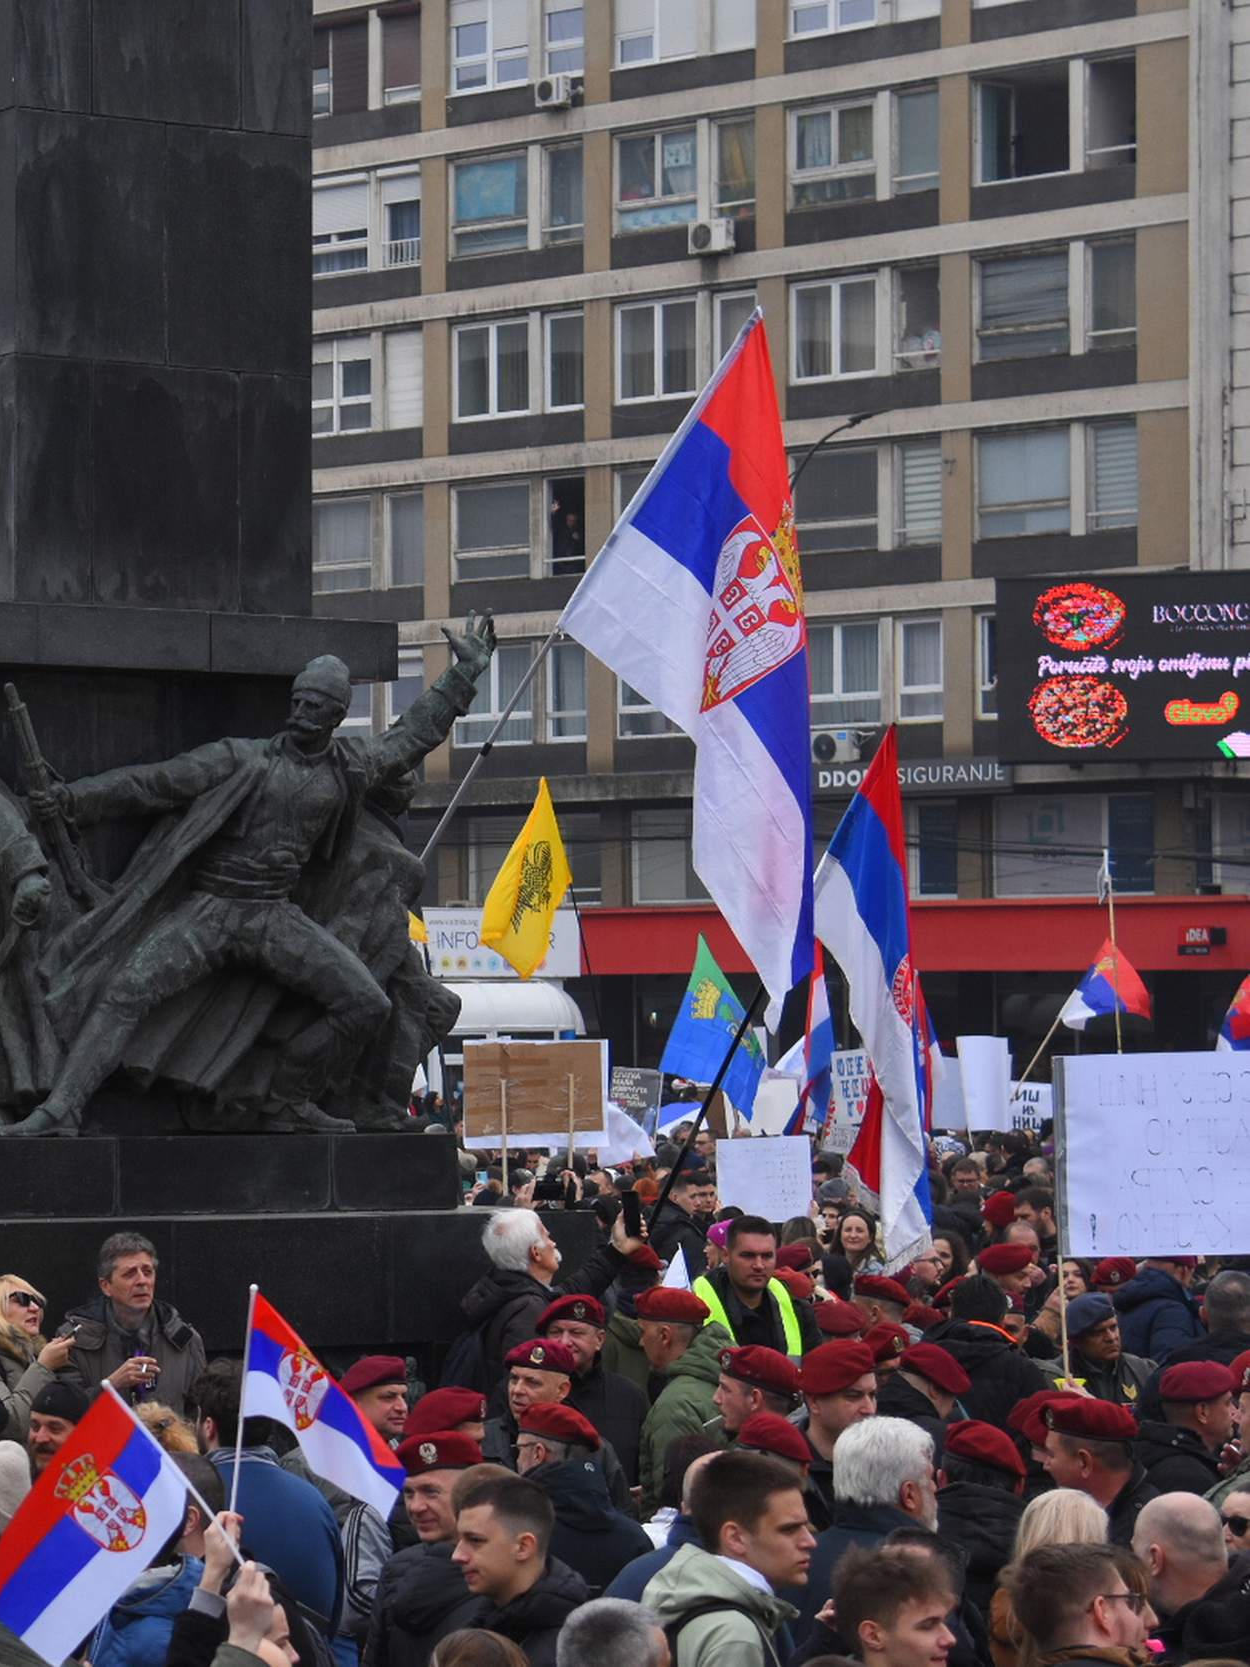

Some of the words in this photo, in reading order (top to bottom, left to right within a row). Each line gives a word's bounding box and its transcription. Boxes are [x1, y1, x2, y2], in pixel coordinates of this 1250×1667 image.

[1112, 656, 1154, 680] svoju
[897, 763, 1004, 785] SIGURANJE
[436, 931, 479, 950] INFO
